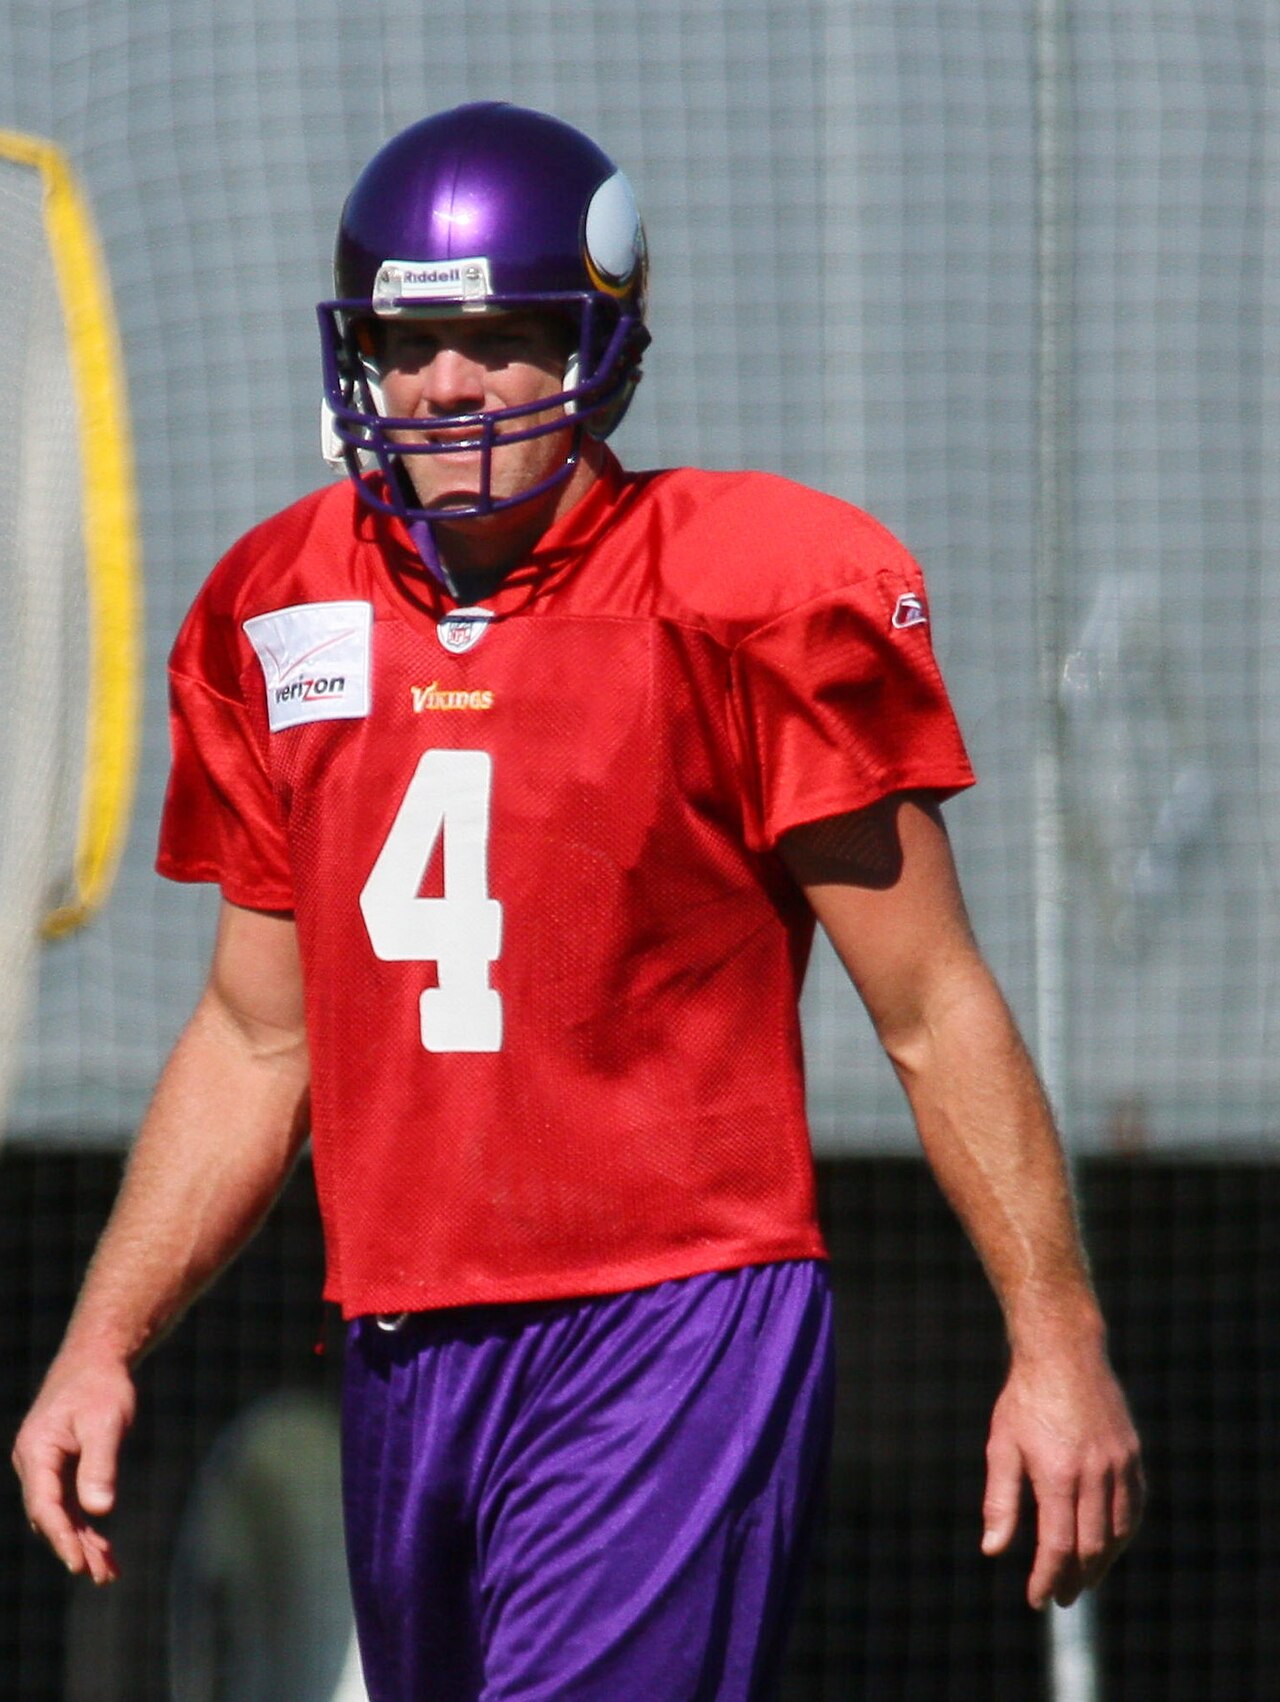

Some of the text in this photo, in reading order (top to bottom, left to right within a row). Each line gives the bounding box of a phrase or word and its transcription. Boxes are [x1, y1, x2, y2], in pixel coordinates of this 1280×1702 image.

[403, 268, 461, 284] Riddell
[274, 673, 346, 704] verizon
[359, 748, 504, 1053] 4
